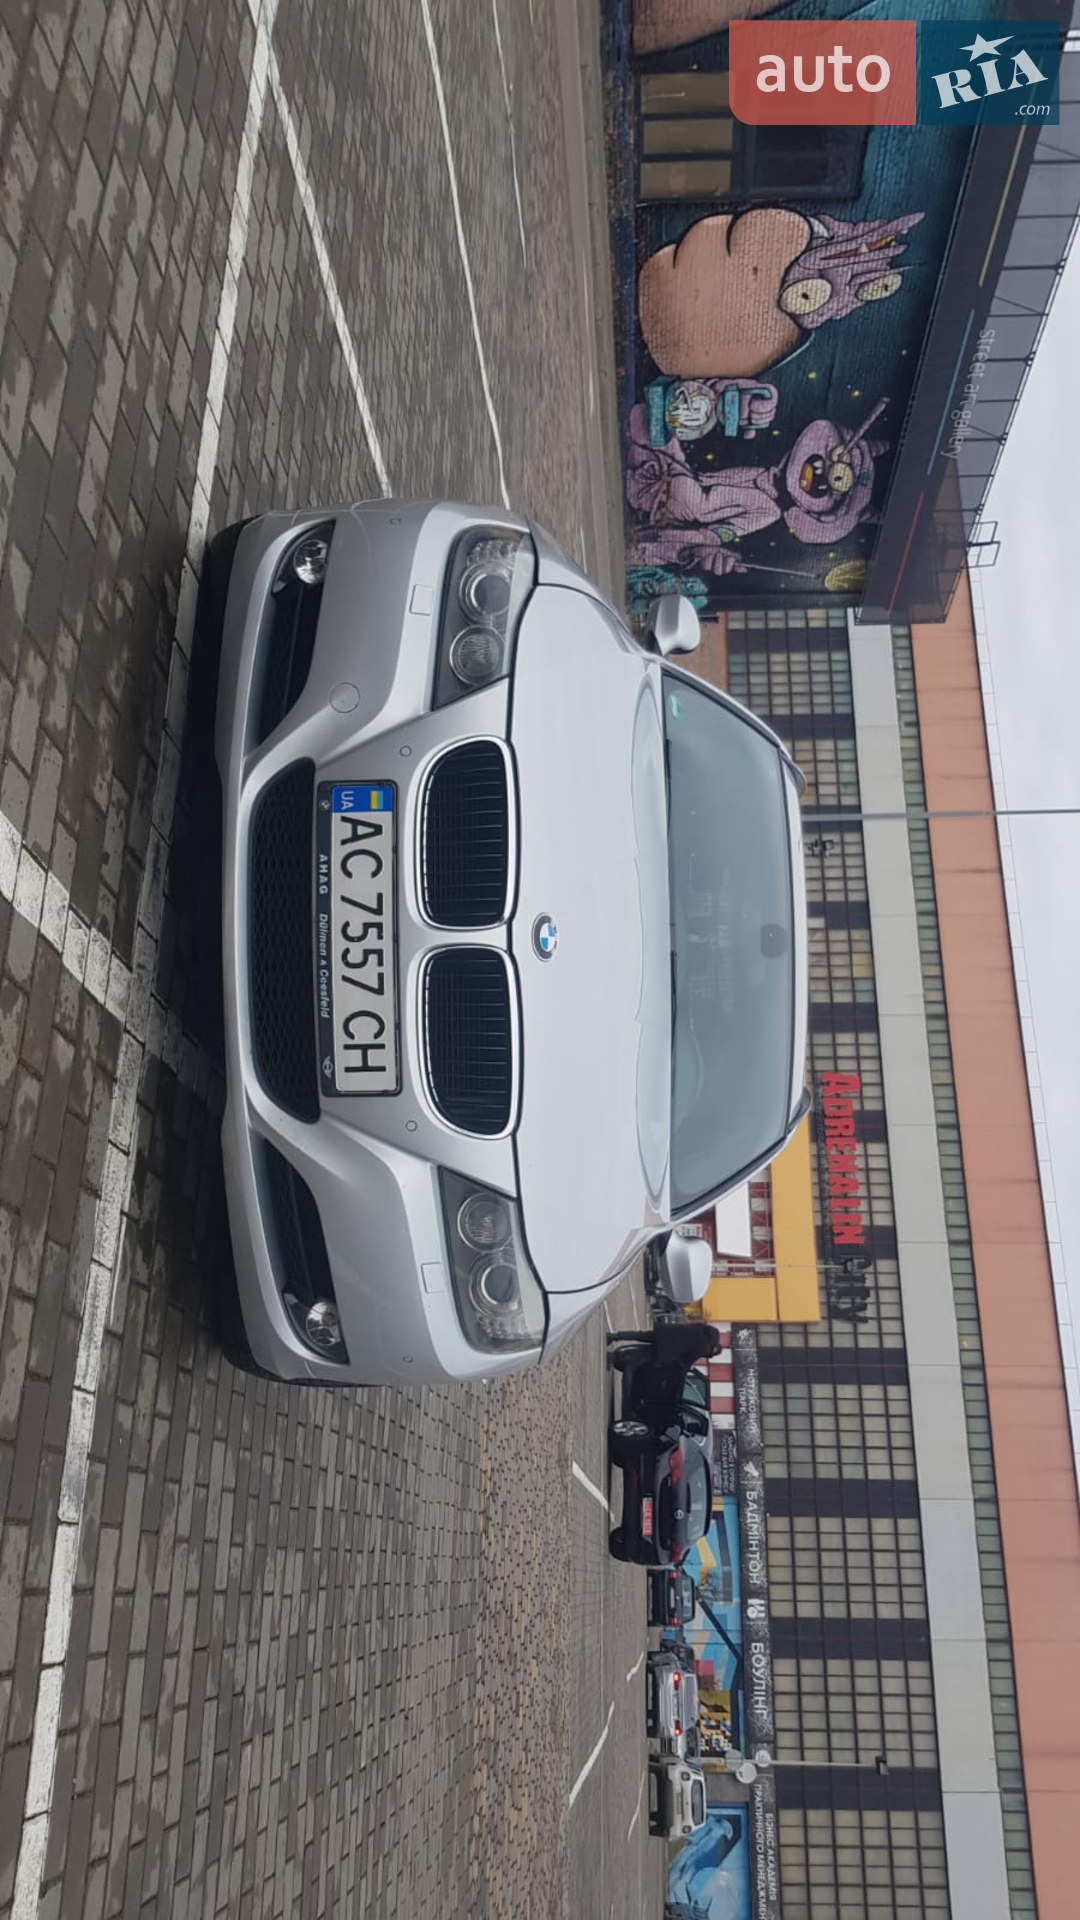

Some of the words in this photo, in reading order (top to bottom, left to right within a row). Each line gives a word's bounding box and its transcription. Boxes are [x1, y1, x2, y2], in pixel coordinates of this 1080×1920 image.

[967, 329, 996, 379] street
[960, 384, 980, 406] art
[940, 410, 972, 459] gallery
[340, 790, 354, 810] UA
[340, 816, 383, 880] AC
[318, 854, 328, 895] AHAG
[318, 913, 328, 956] Dülmen
[340, 892, 384, 996] 7557
[319, 969, 330, 1018] Coesfeld
[342, 1010, 386, 1073] CH
[821, 1072, 866, 1245] ADRENALIN
[738, 1387, 747, 1414] ПАРК
[745, 1491, 761, 1584] БАДМІНТОН
[751, 1642, 768, 1719] БОУЛІНГ
[754, 1783, 764, 1852] ПРАКТИЧНОГО
[765, 1813, 775, 1846] БІЗНЕС
[756, 1854, 767, 1920] МЕНЕДЖМЕН
[766, 1848, 777, 1901] АКАДЕМІЯ
